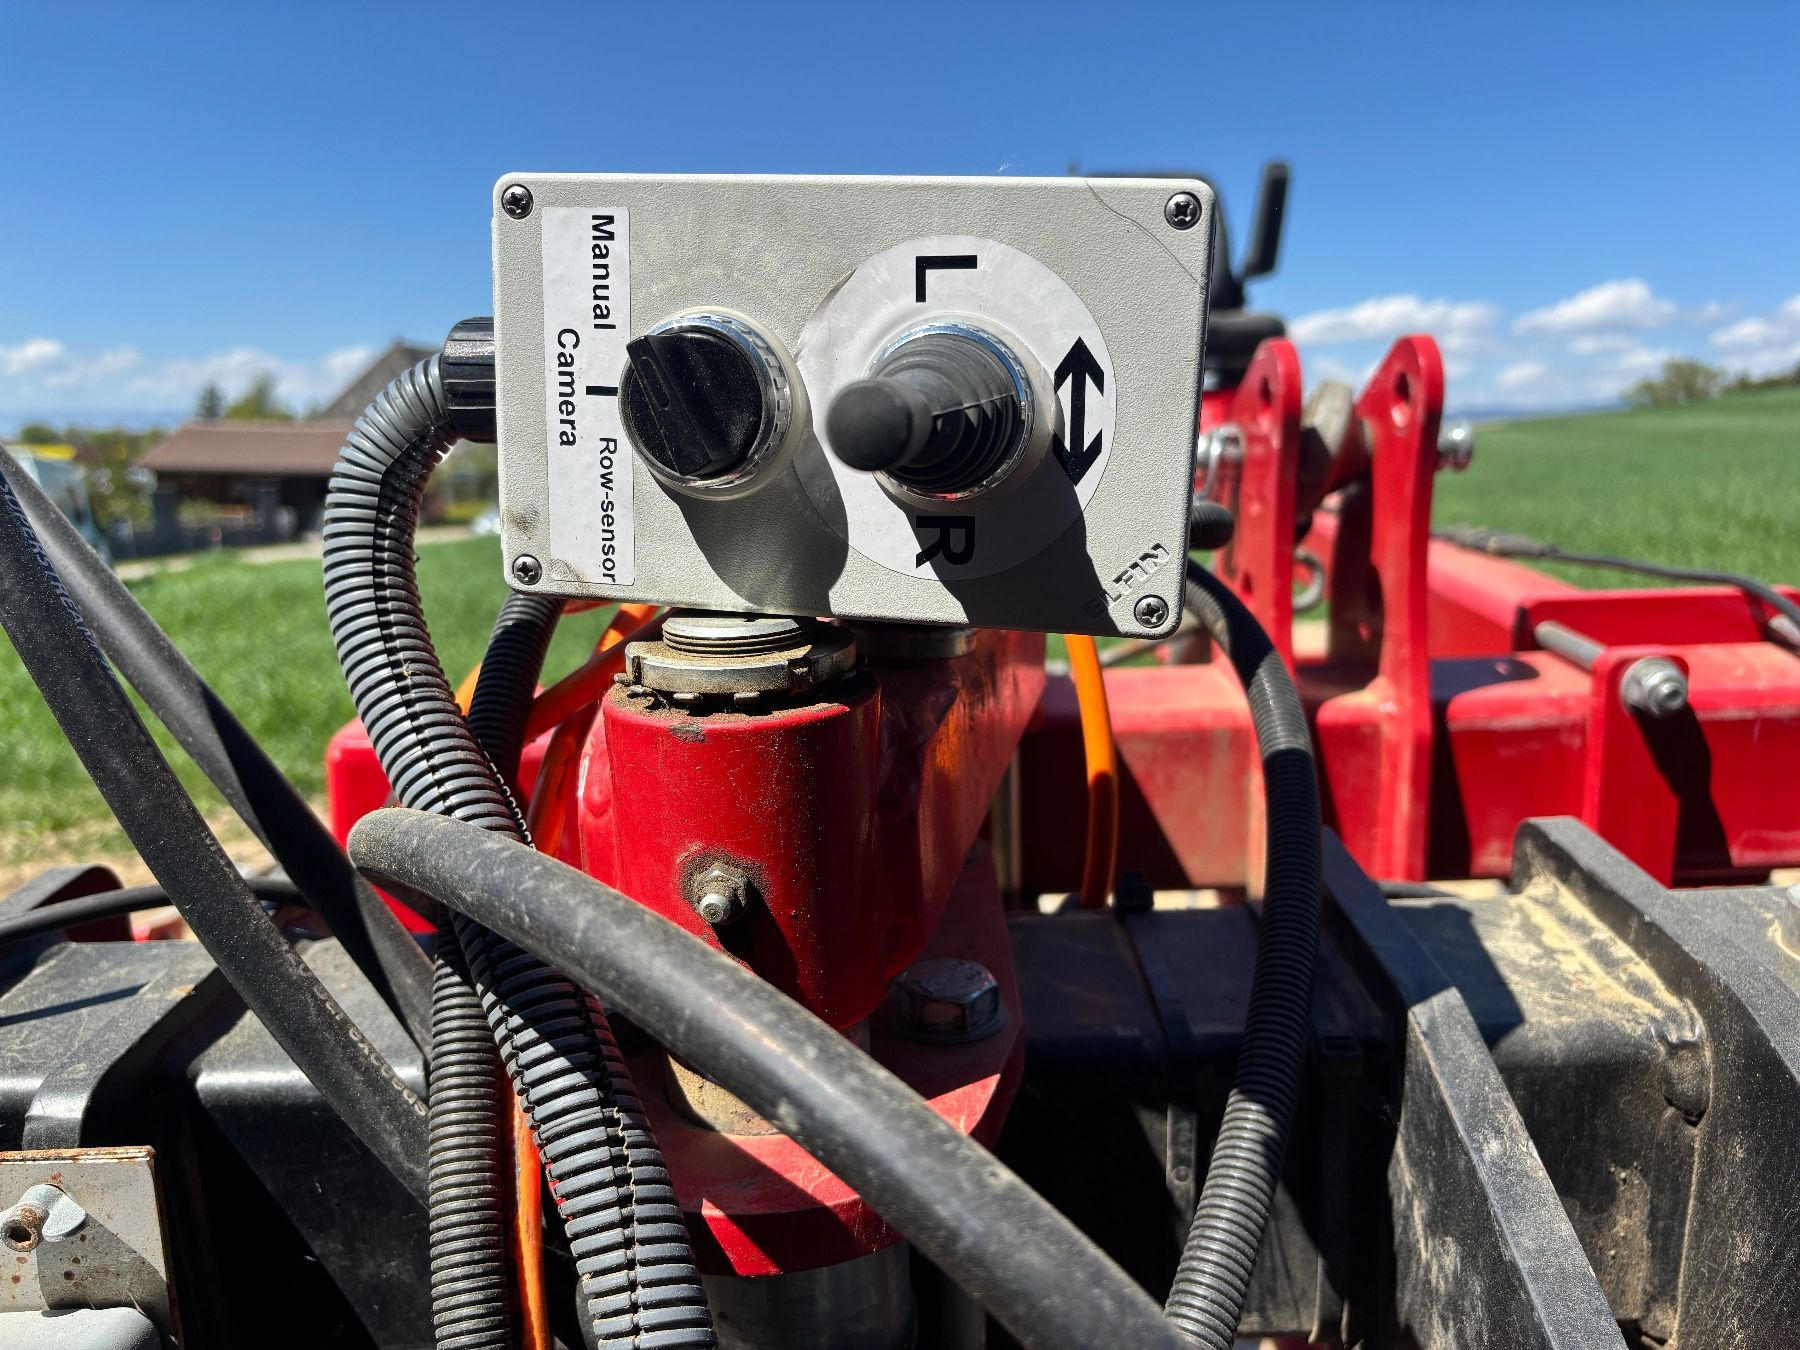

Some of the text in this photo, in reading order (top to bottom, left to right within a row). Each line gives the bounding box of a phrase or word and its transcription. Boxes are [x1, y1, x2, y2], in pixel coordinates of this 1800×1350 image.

[592, 214, 616, 329] Manual
[916, 254, 977, 302] L
[557, 328, 580, 447] Camera
[600, 437, 618, 583] Row-sensor
[916, 515, 975, 569] R
